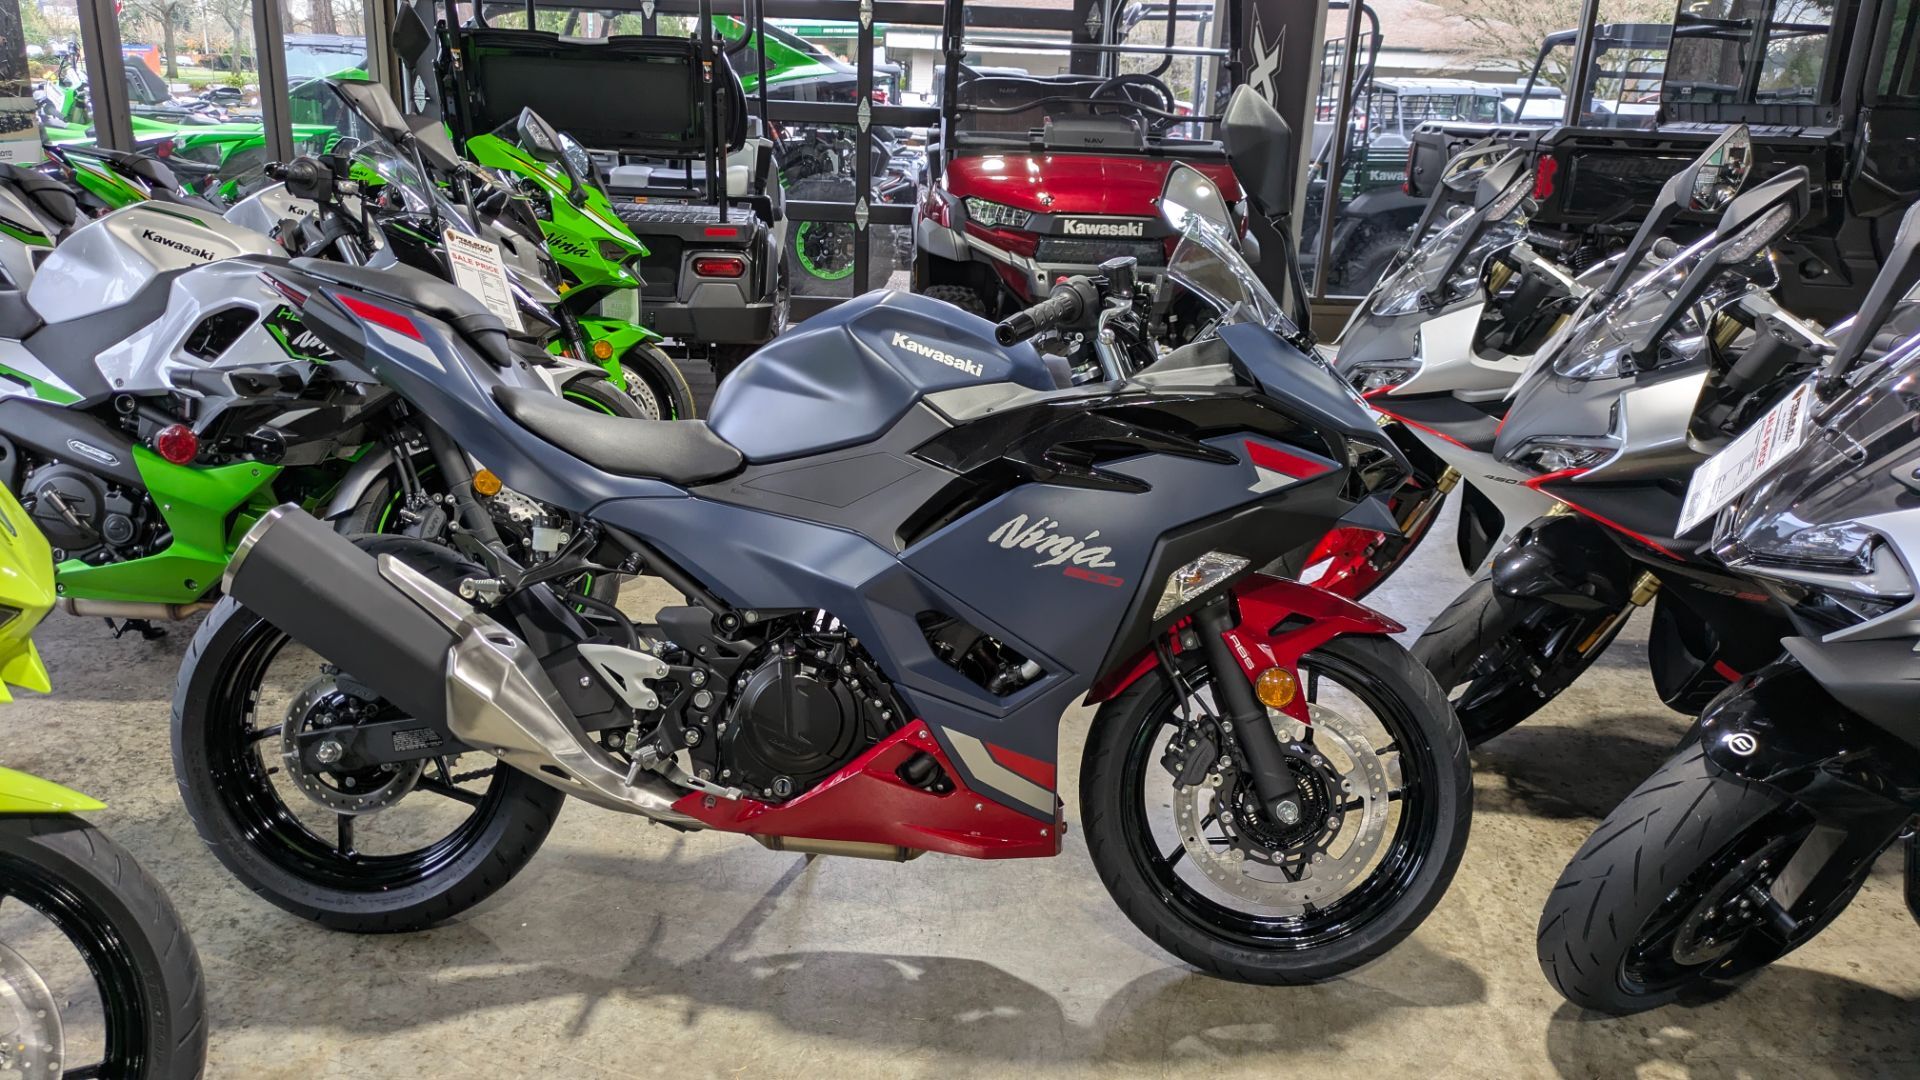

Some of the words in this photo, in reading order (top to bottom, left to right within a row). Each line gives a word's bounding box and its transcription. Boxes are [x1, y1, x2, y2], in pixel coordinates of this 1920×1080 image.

[1063, 219, 1143, 236] Kawasaki
[142, 229, 216, 261] Kawasaki
[545, 232, 591, 258] Ninja
[451, 252, 475, 265] SALE
[475, 261, 500, 275] PRICE
[891, 331, 984, 377] Kawasaki
[988, 513, 1116, 568] Ninja
[1229, 634, 1255, 670] ABS
